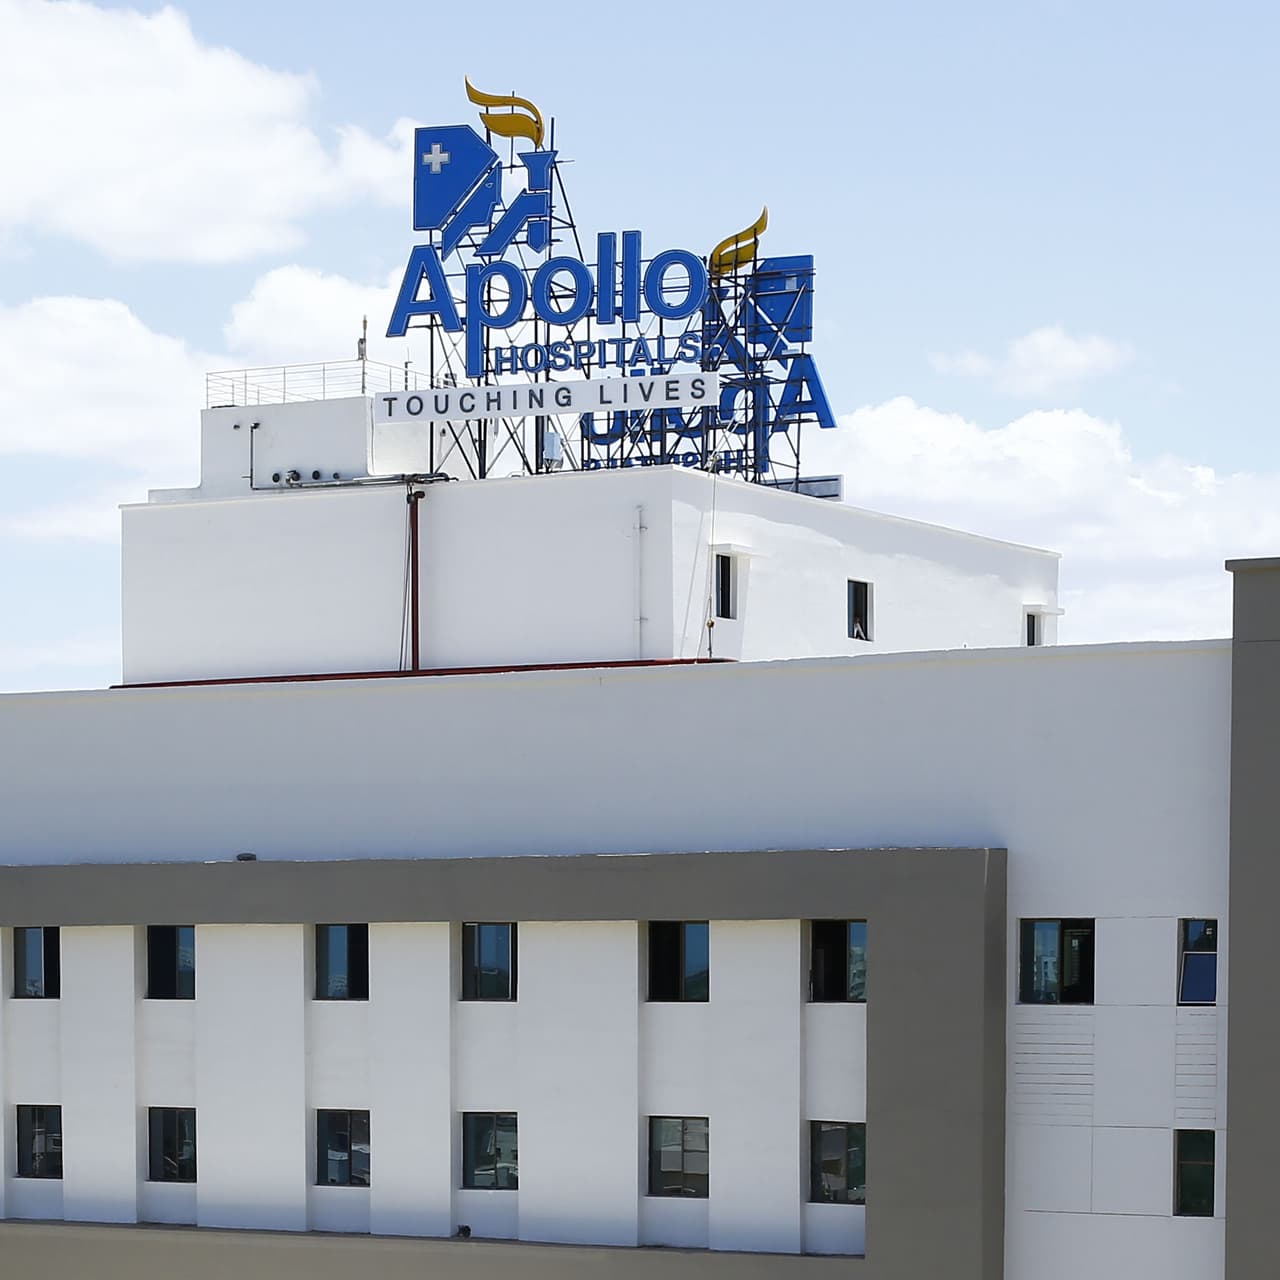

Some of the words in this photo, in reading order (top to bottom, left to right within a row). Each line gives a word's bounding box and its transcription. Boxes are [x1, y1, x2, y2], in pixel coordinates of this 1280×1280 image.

[386, 230, 709, 378] Apollo
[493, 333, 704, 375] HOSPITALS
[382, 385, 574, 418] TOUCHING
[598, 377, 710, 406] LIVES
